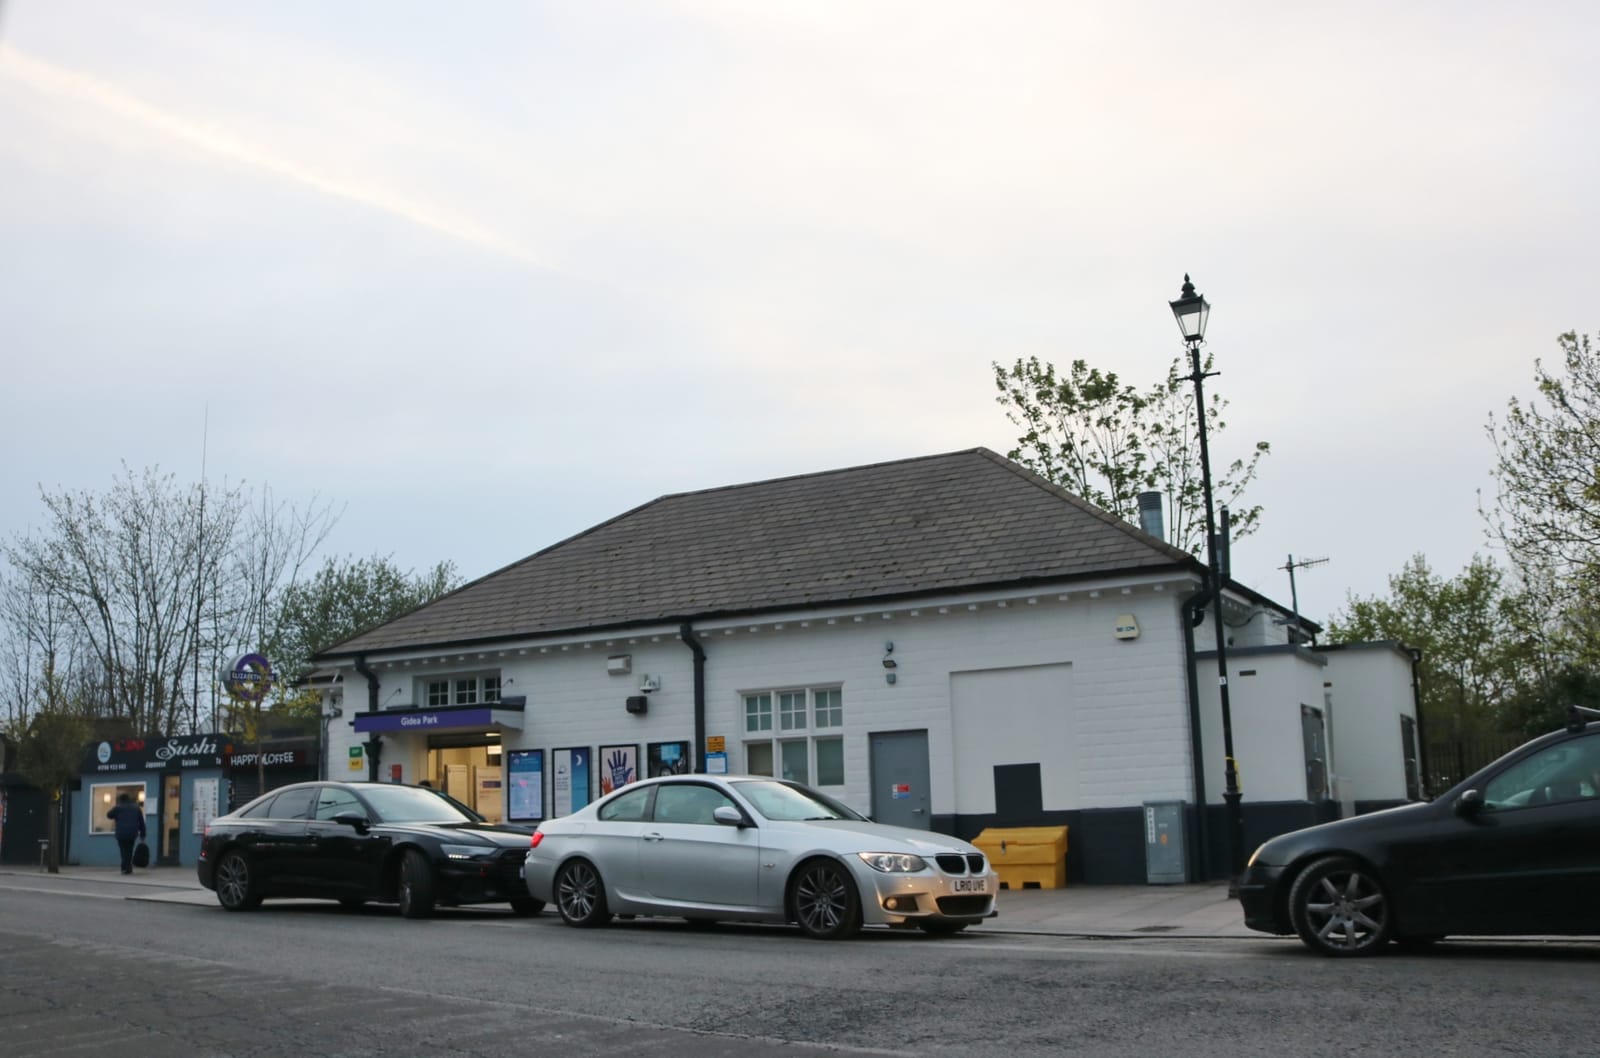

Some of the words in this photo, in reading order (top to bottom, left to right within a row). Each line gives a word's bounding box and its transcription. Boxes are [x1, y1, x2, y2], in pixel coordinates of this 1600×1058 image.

[400, 716, 421, 726] Gidea
[422, 714, 438, 725] Park
[155, 737, 217, 761] Sushi
[230, 752, 259, 767] HAPPY
[954, 880, 971, 892] LR10
